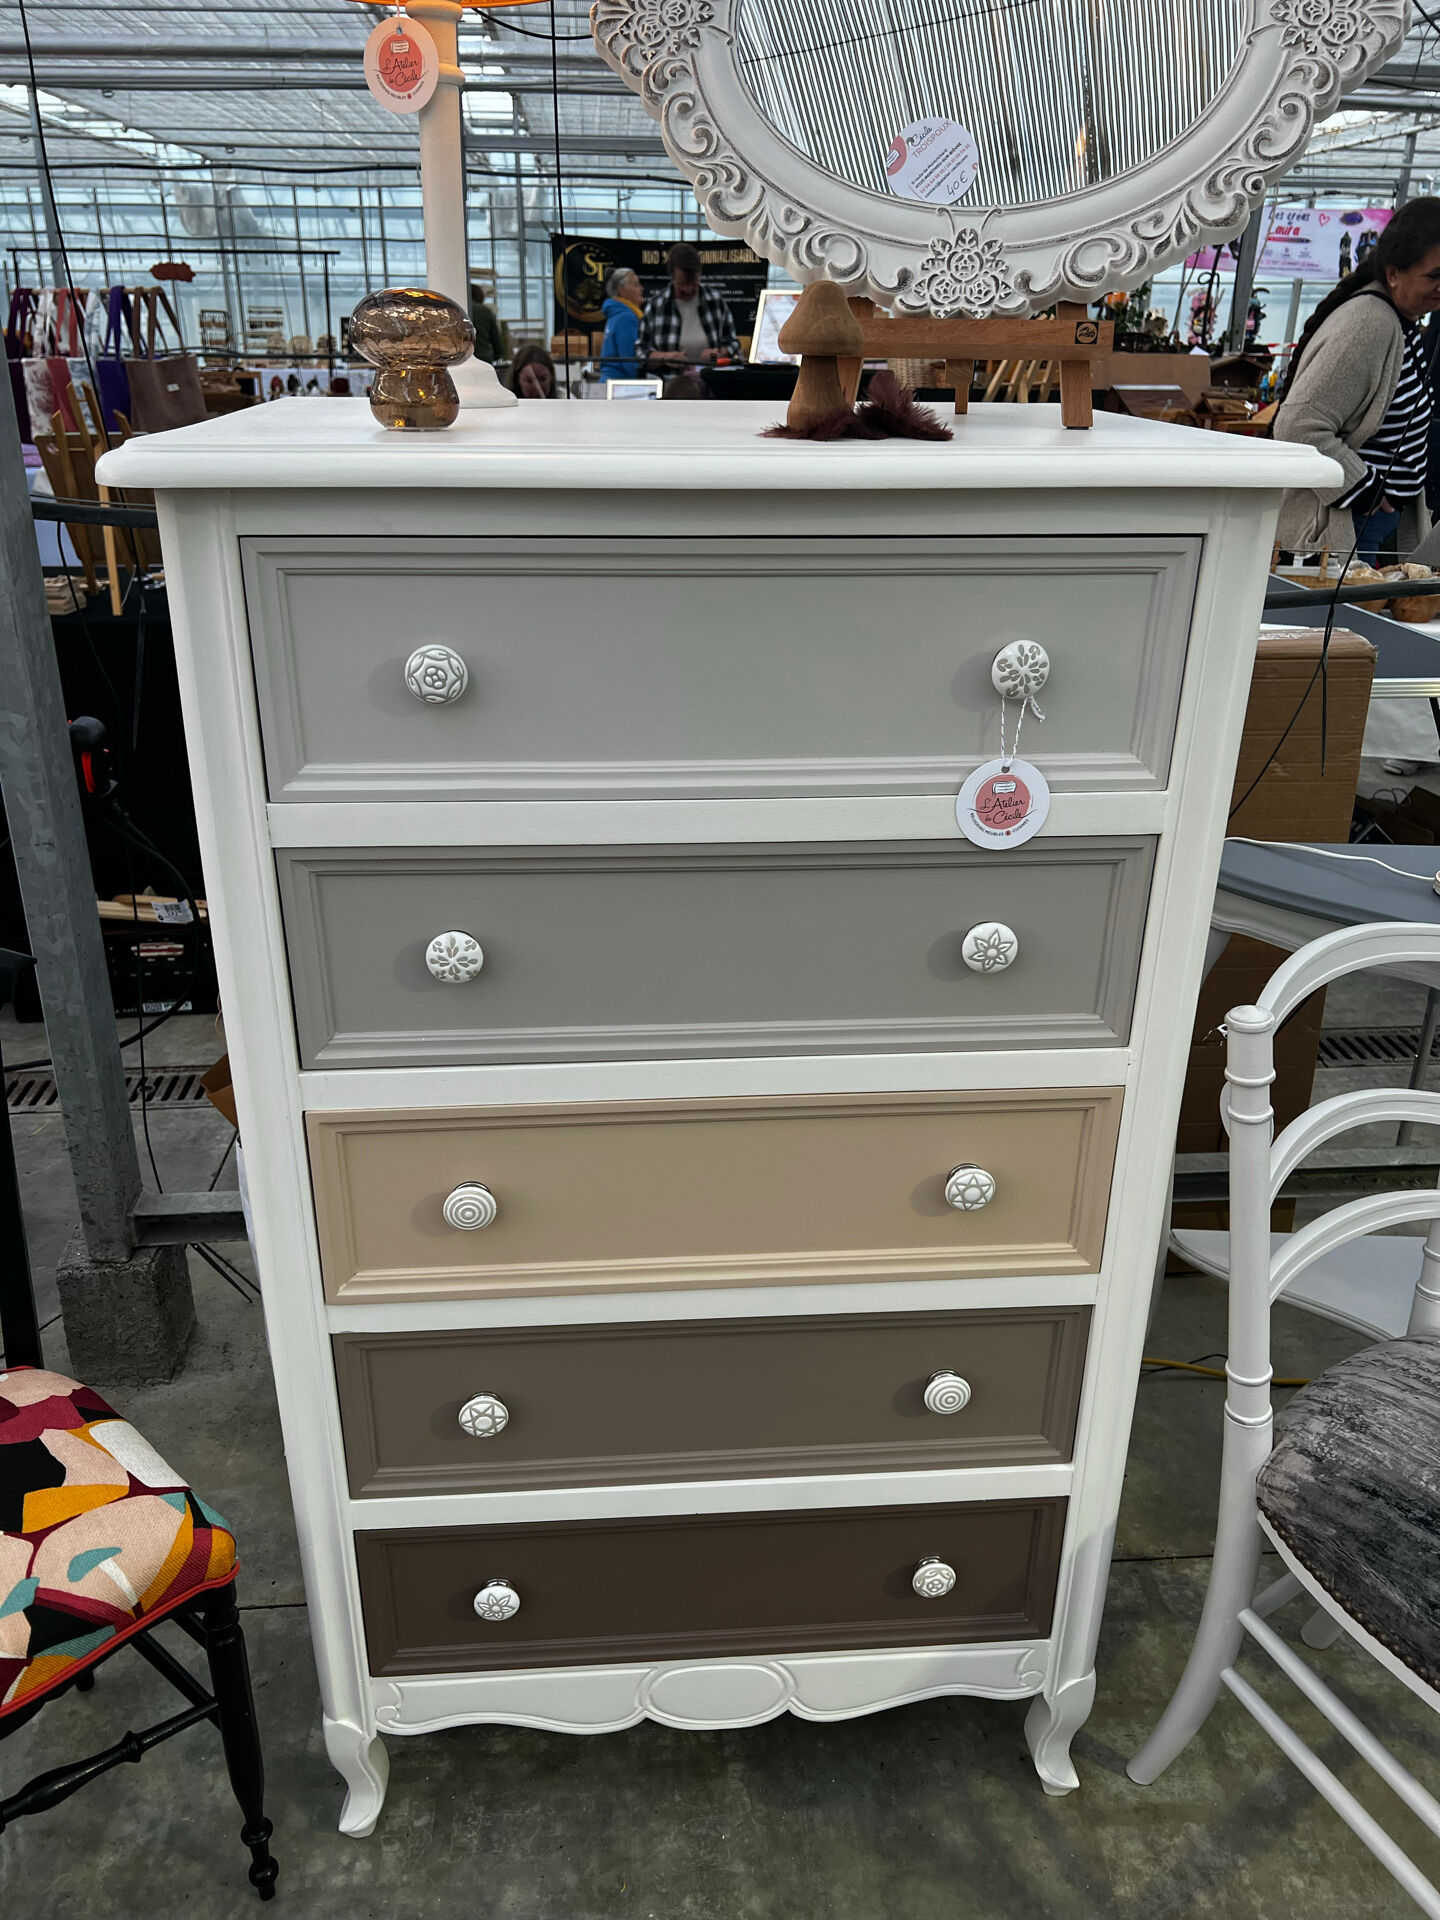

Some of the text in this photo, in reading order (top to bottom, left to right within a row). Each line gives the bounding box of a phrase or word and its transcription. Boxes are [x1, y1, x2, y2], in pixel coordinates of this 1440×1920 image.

[913, 121, 952, 157] TROISPOUX
[582, 253, 614, 281] ST
[980, 797, 1025, 810] L'Atelier
[992, 809, 1023, 825] Cécile
